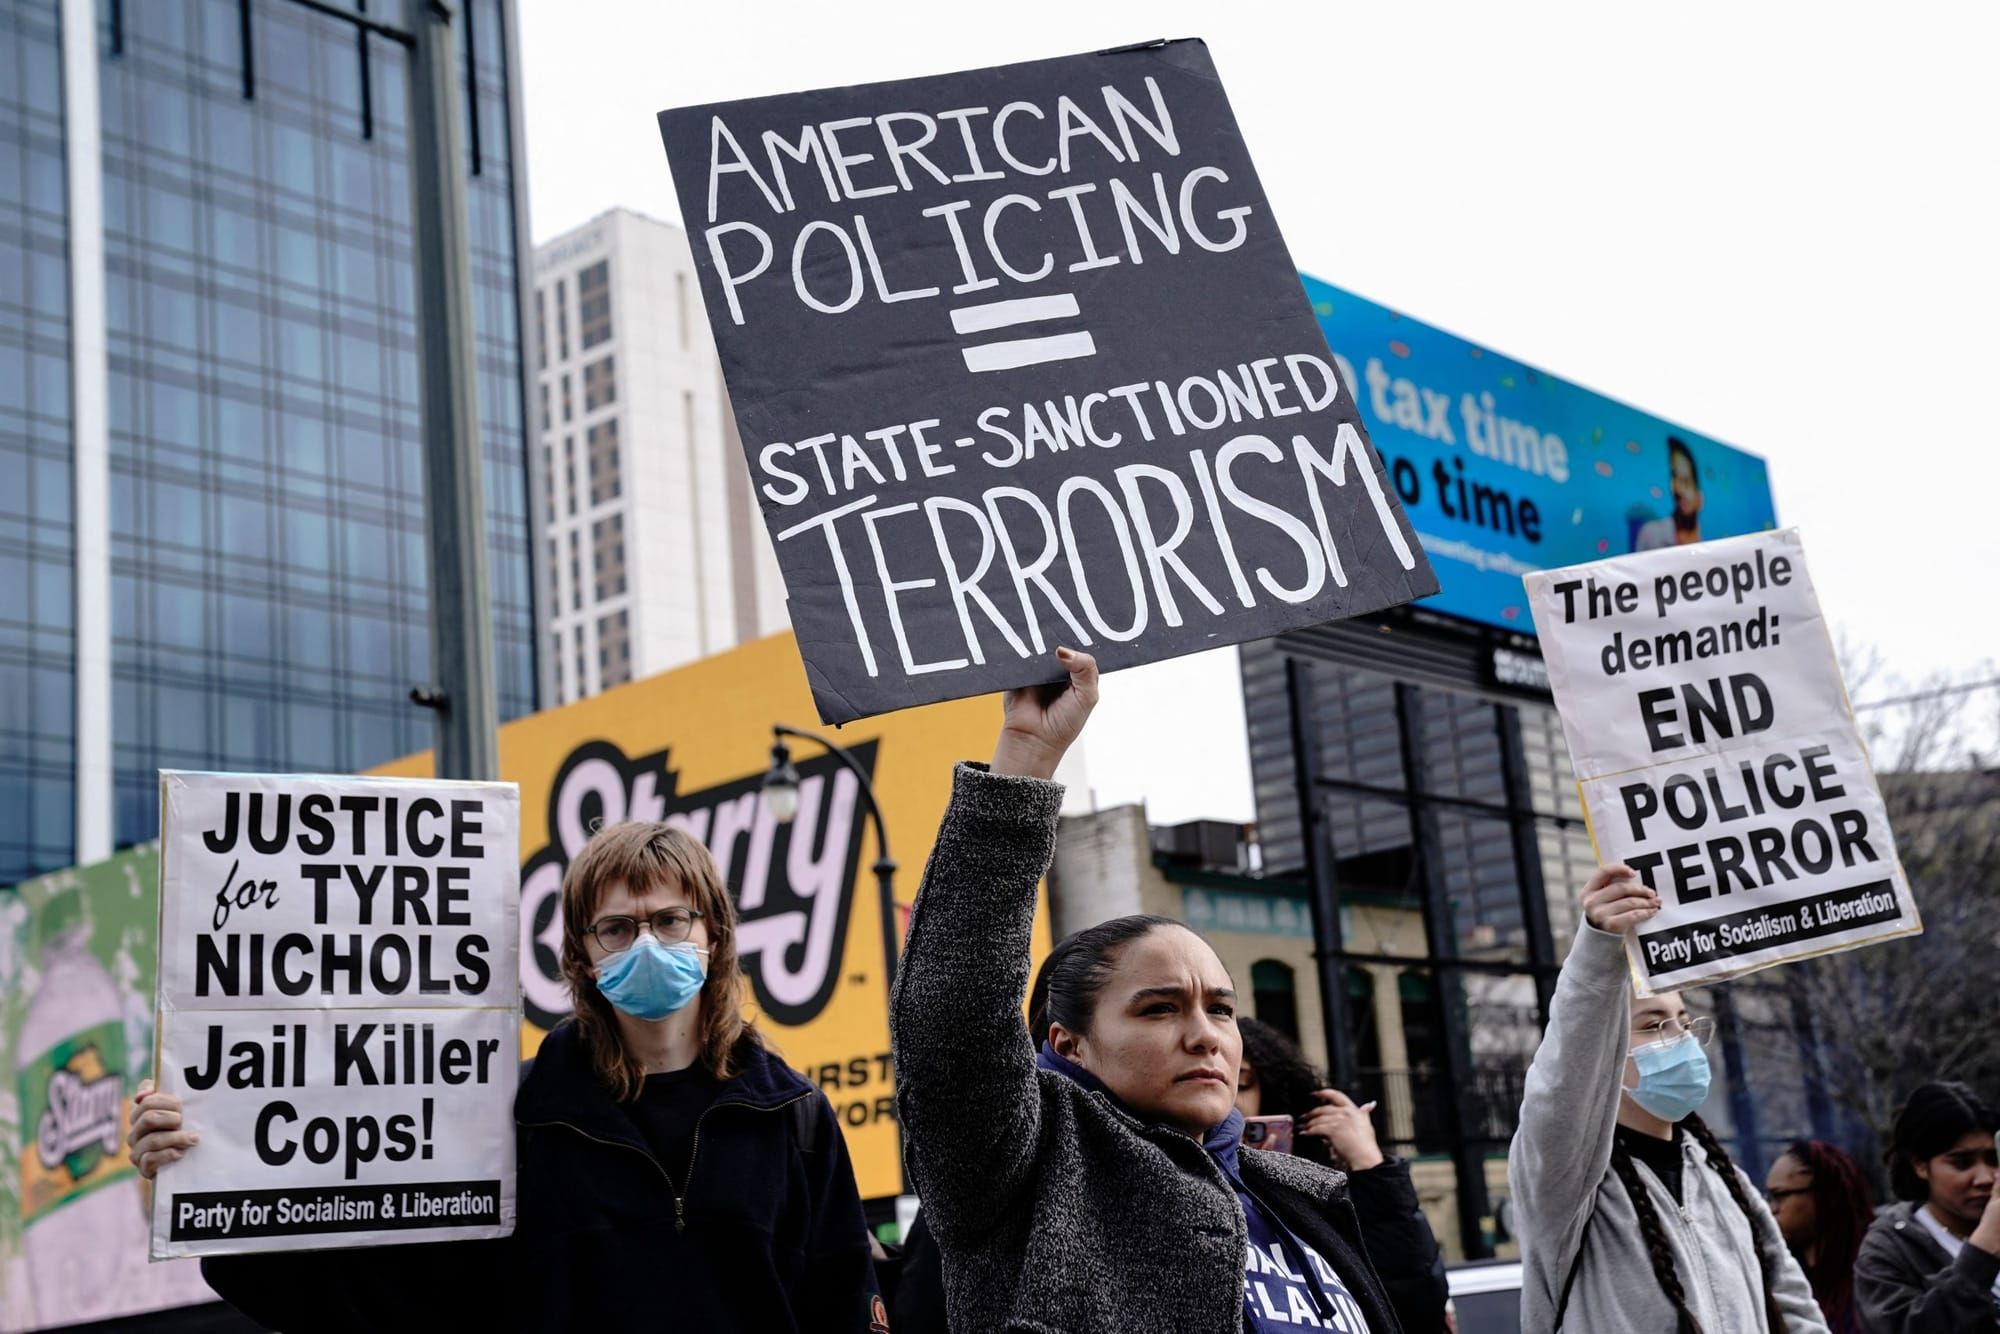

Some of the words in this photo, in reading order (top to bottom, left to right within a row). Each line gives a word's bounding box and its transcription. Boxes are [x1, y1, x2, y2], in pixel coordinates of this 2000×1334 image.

[708, 76, 1181, 222] AMERICAN
[705, 166, 1252, 325] POLICING
[759, 353, 1338, 505] STATE-SANCTIONED
[1365, 357, 1456, 445] tax
[1459, 391, 1570, 483] time
[1433, 456, 1542, 543] time
[777, 423, 1416, 677] TERRORISM
[1554, 577, 1638, 624] The
[1655, 549, 1792, 617] people
[1601, 606, 1780, 676] demand:
[1638, 672, 1775, 753] END
[202, 792, 484, 859] JUSTICE
[1619, 744, 1846, 842] POLICE
[212, 860, 280, 931] for
[301, 864, 471, 926] TYRE
[1624, 809, 1879, 905] TERROR
[196, 933, 491, 997] NICHOLS
[1647, 939, 1692, 965] Party
[1693, 930, 1717, 954] for
[1719, 915, 1797, 948] Socialism
[1800, 905, 1815, 929] &
[1816, 891, 1895, 927] Liberation
[184, 1025, 306, 1091] Jail
[334, 1024, 499, 1087] Killer
[806, 1052, 893, 1089] IRST
[254, 1098, 434, 1180] Cops!
[178, 1201, 235, 1234] Party
[241, 1199, 272, 1226] for
[276, 1195, 374, 1224] Socialism
[380, 1193, 395, 1219] &
[401, 1190, 494, 1218] Liberation
